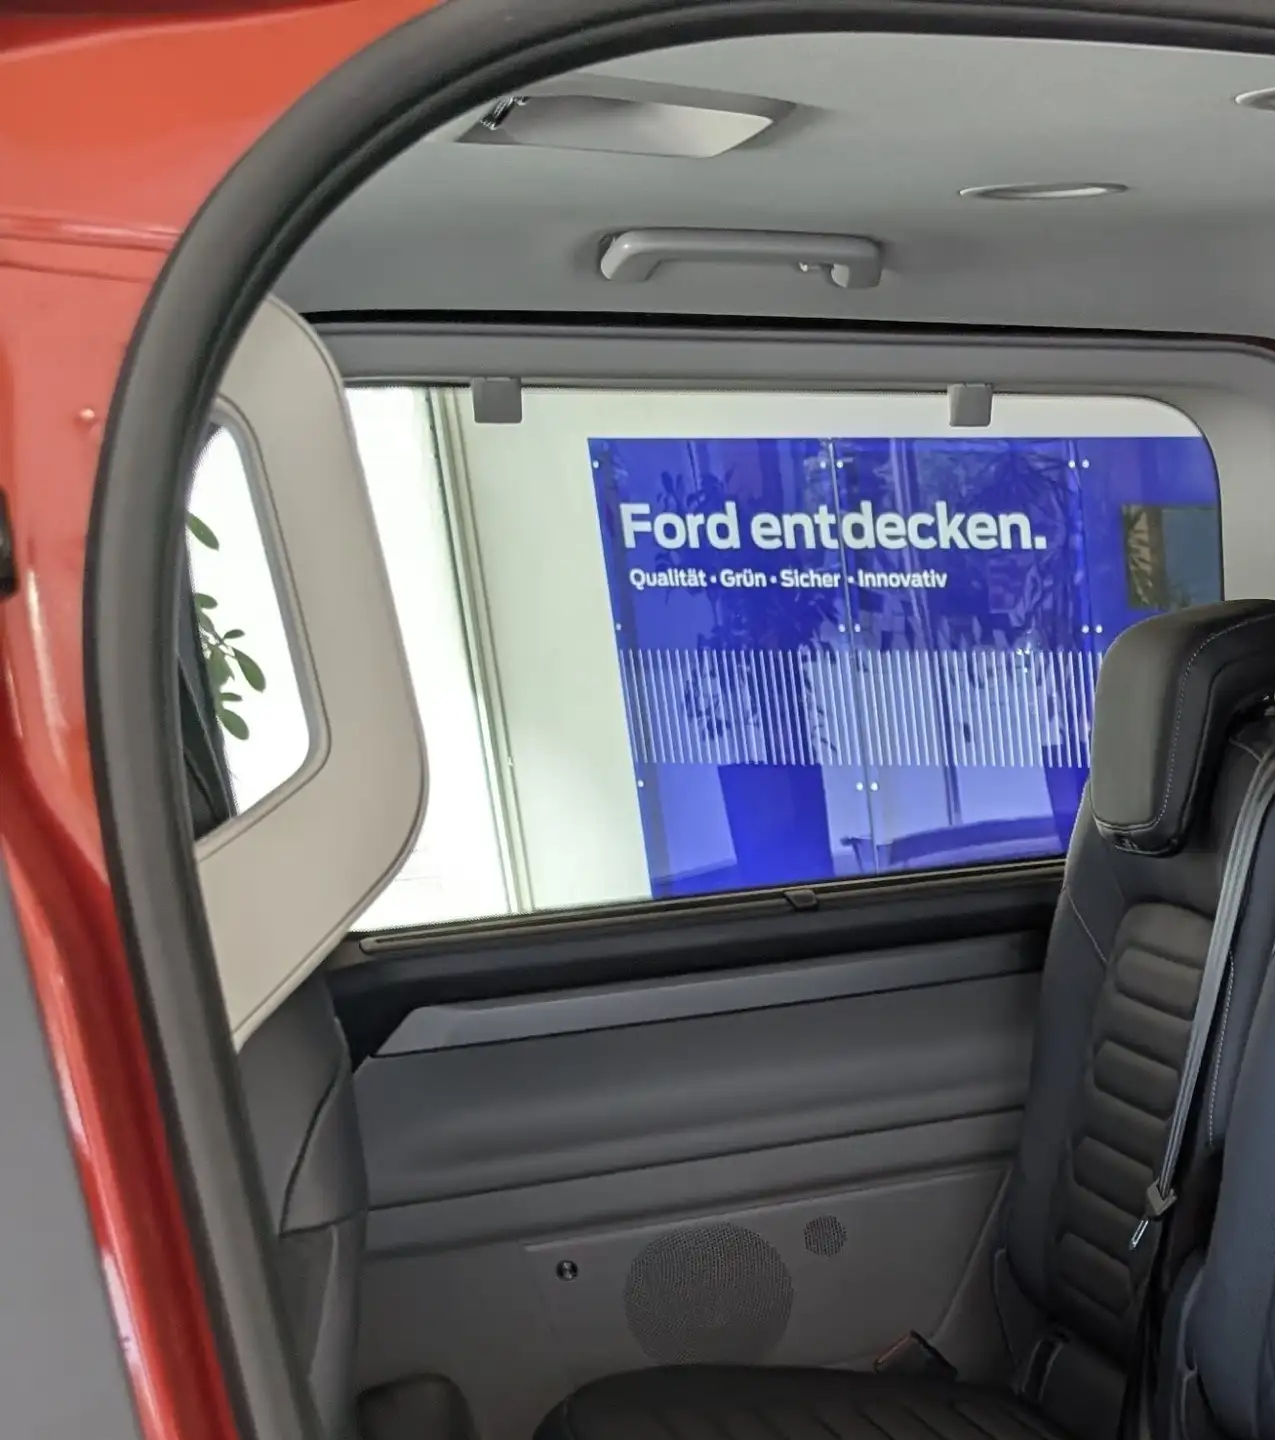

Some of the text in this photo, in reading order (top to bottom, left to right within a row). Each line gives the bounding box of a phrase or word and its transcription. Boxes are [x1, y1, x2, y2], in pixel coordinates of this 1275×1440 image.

[620, 500, 1047, 550] Ford entdecken.
[629, 568, 947, 591] Qualität Grün Sicher Innovativ
